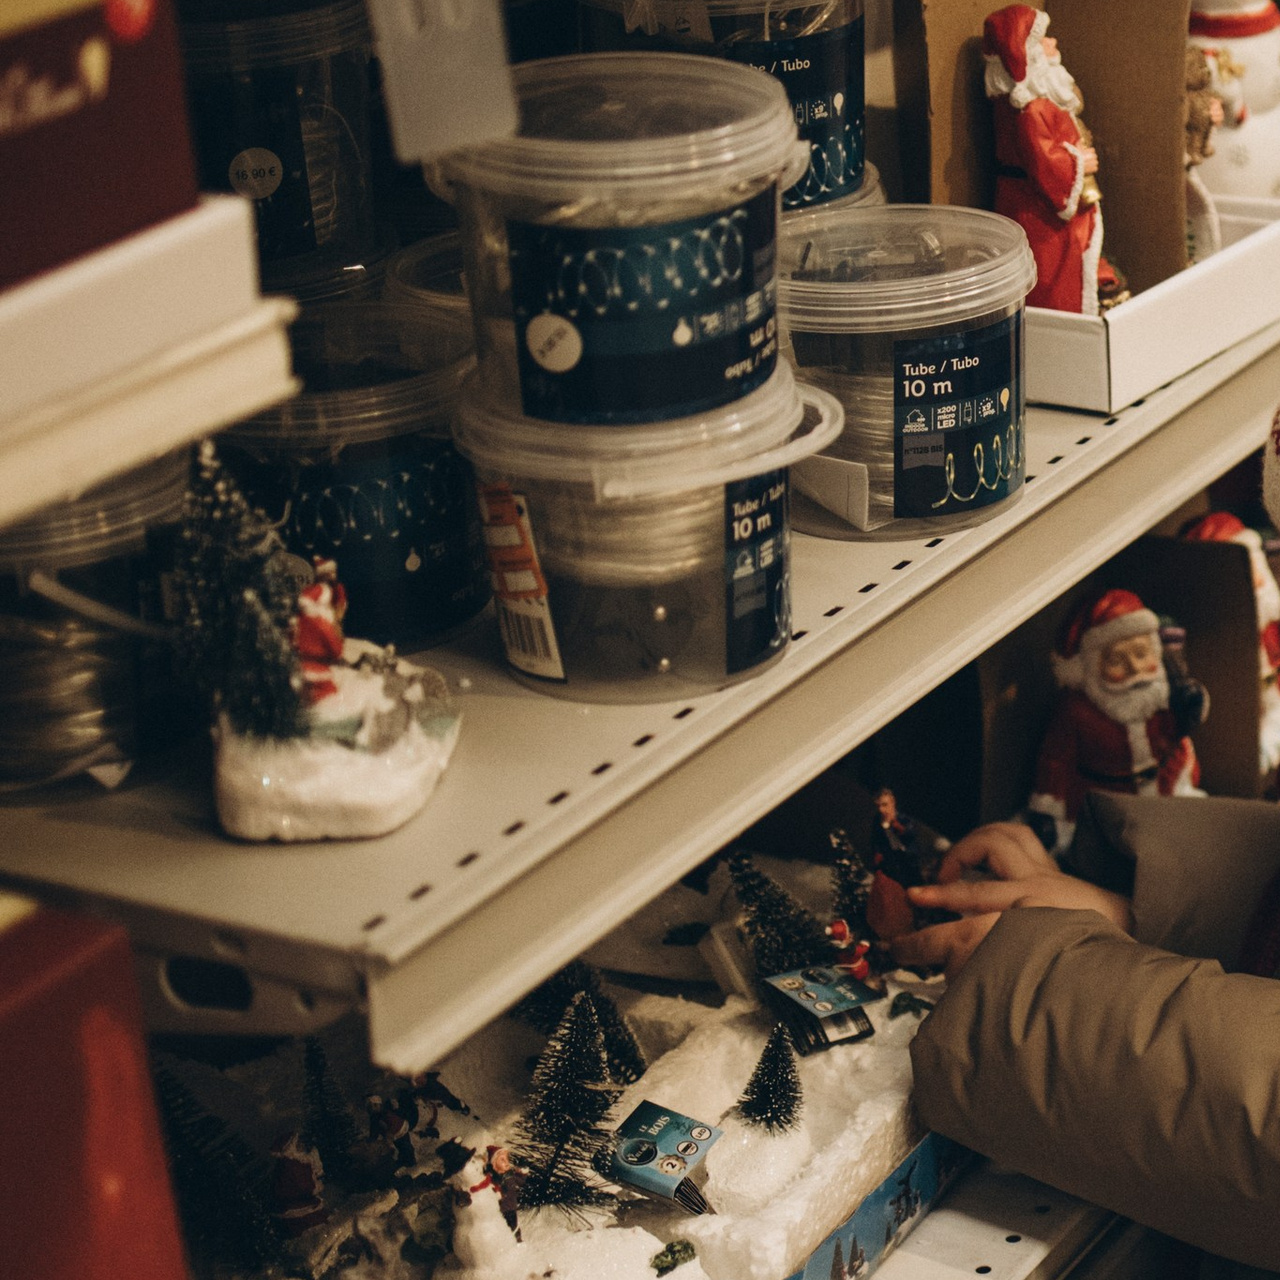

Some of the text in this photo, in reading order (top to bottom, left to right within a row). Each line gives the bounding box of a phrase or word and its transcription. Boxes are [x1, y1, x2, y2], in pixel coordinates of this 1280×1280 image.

[781, 58, 811, 72] Tubo
[902, 363, 936, 376] Tube
[950, 356, 979, 371] Tubo
[902, 379, 952, 398] 10 m
[937, 405, 957, 414] x200
[937, 419, 956, 429] LED
[732, 498, 760, 518] Tube
[733, 512, 772, 541] 10 m
[647, 1114, 671, 1136] BOIS
[665, 1160, 677, 1170] 2
